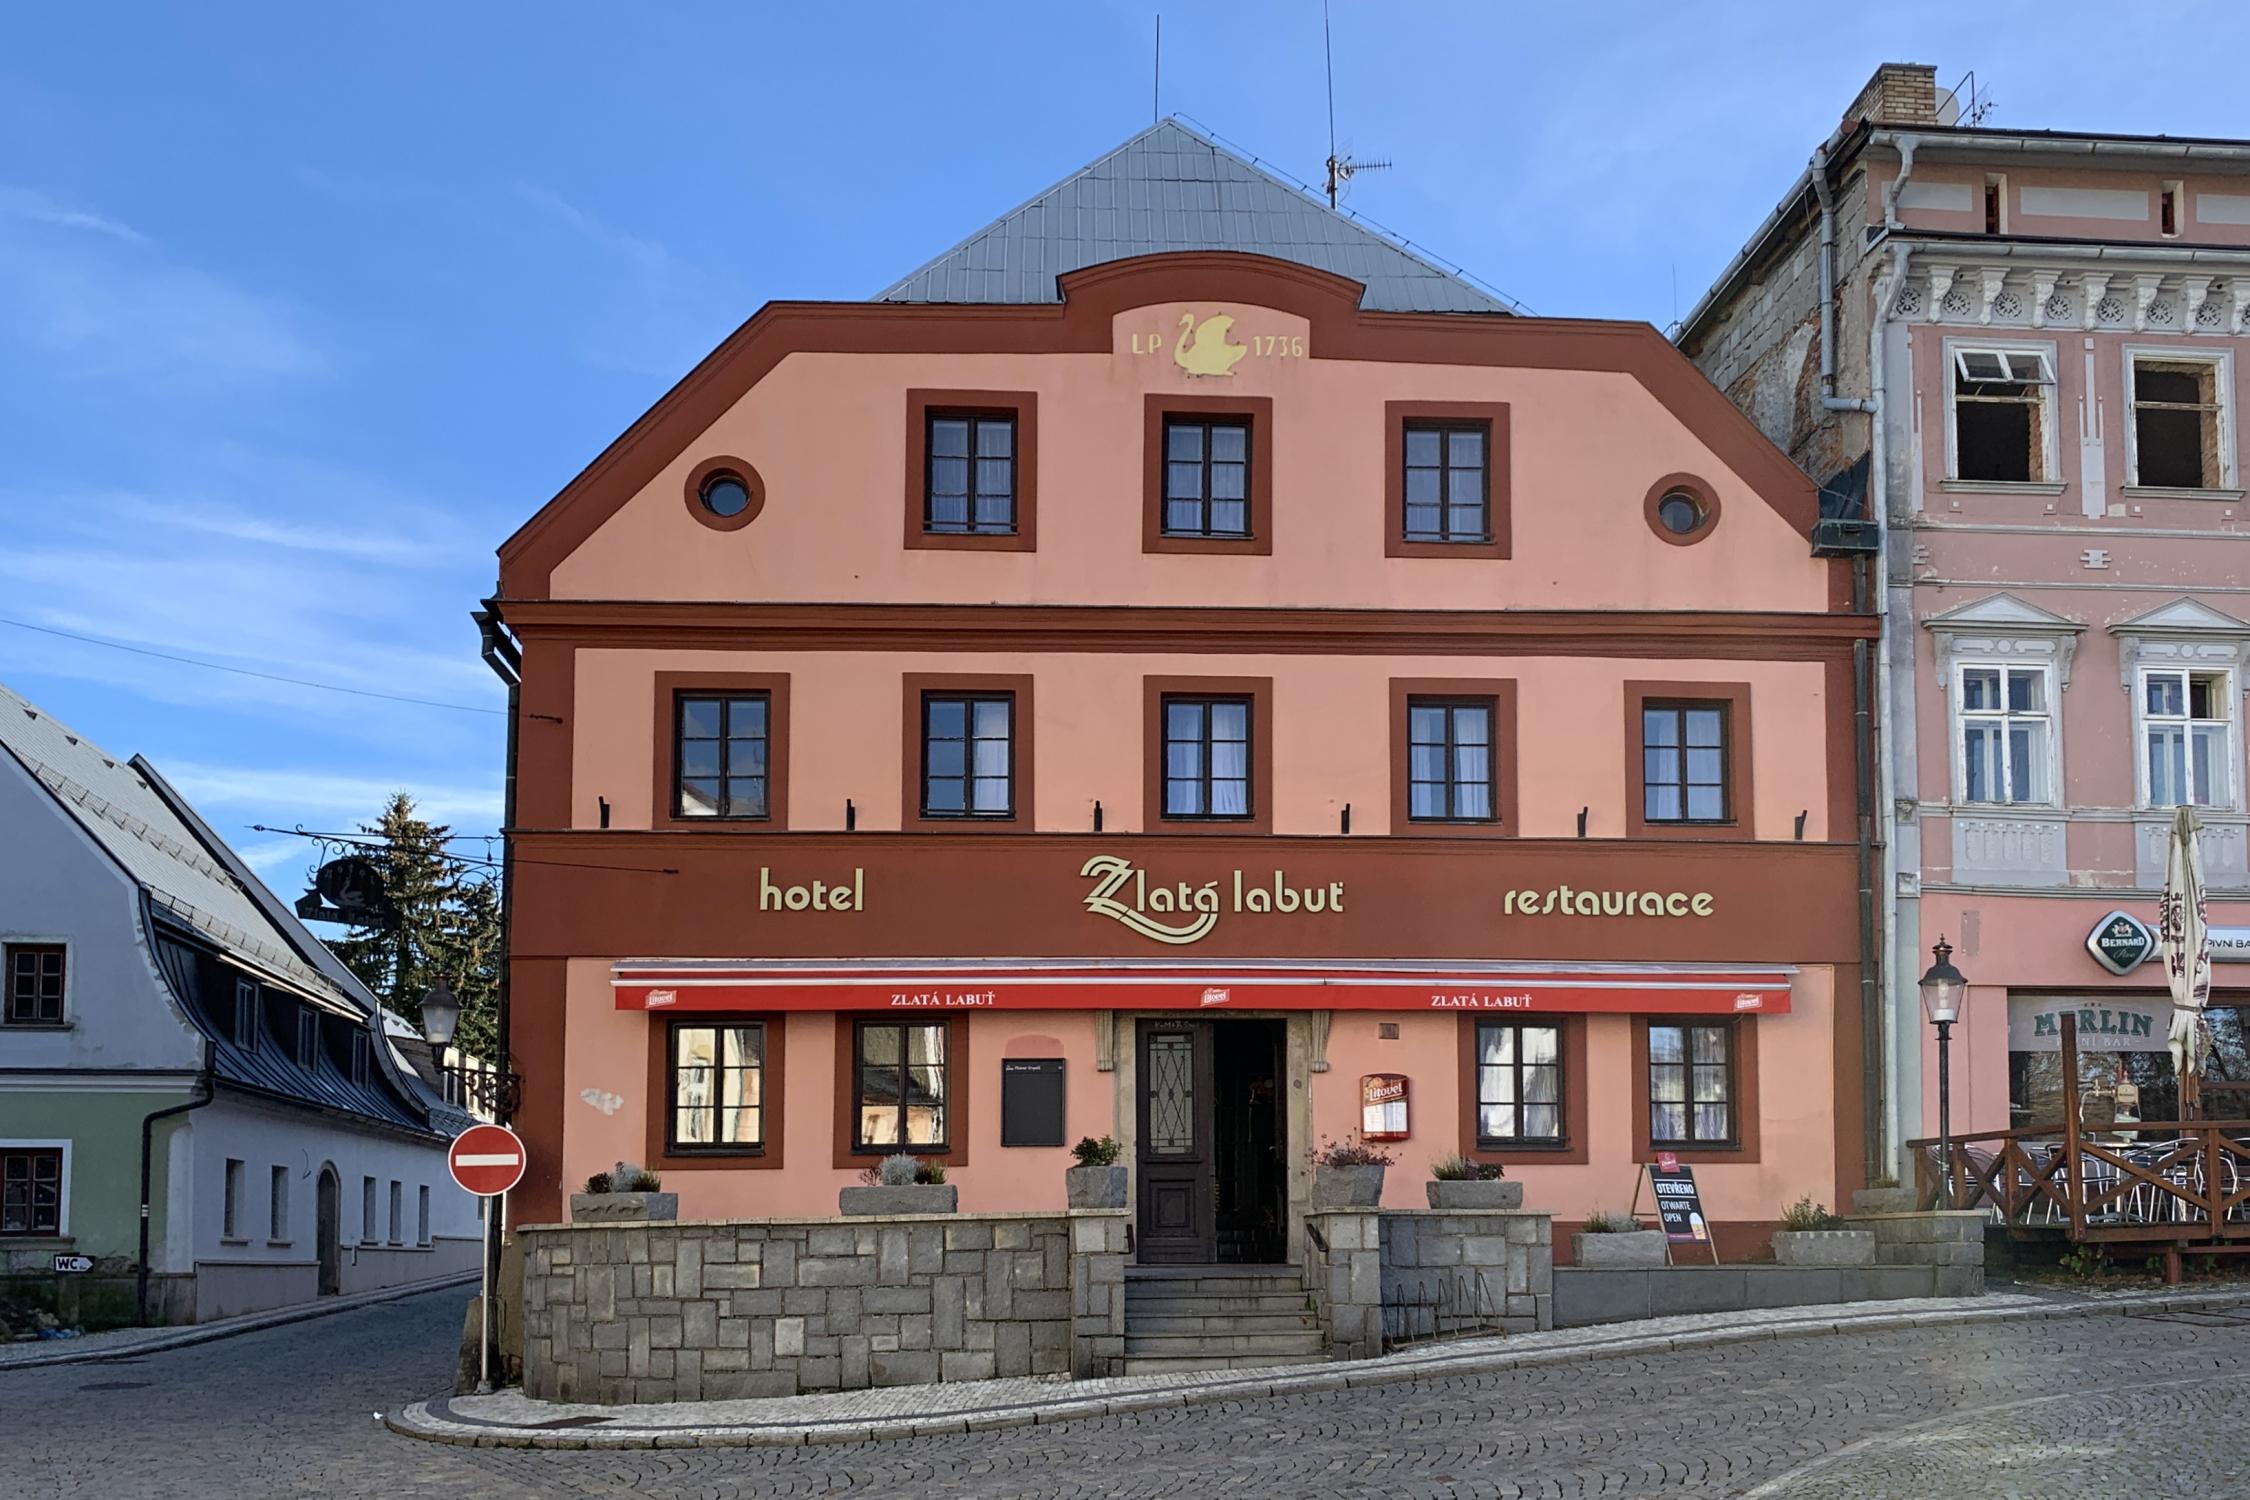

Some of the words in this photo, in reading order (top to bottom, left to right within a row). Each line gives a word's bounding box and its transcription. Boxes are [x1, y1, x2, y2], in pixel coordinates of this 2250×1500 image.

[1252, 335, 1304, 358] 1736
[760, 866, 864, 911] hotel
[1079, 854, 1220, 945] Zlatá
[1233, 869, 1344, 913] labuť
[1504, 884, 1714, 917] restaurace
[890, 991, 940, 1006] ZLATÁ
[945, 990, 996, 1006] LABUŤ
[1431, 993, 1479, 1008] ZLATÁ
[1483, 993, 1533, 1008] LABUŤ
[2034, 1009, 2154, 1037] MRLIN
[1369, 1081, 1403, 1102] Litovel
[1656, 1181, 1695, 1195] OTEVŘENO
[1660, 1200, 1692, 1211] OTWARTE
[1663, 1212, 1682, 1222] OPEN
[57, 1257, 79, 1270] WC
